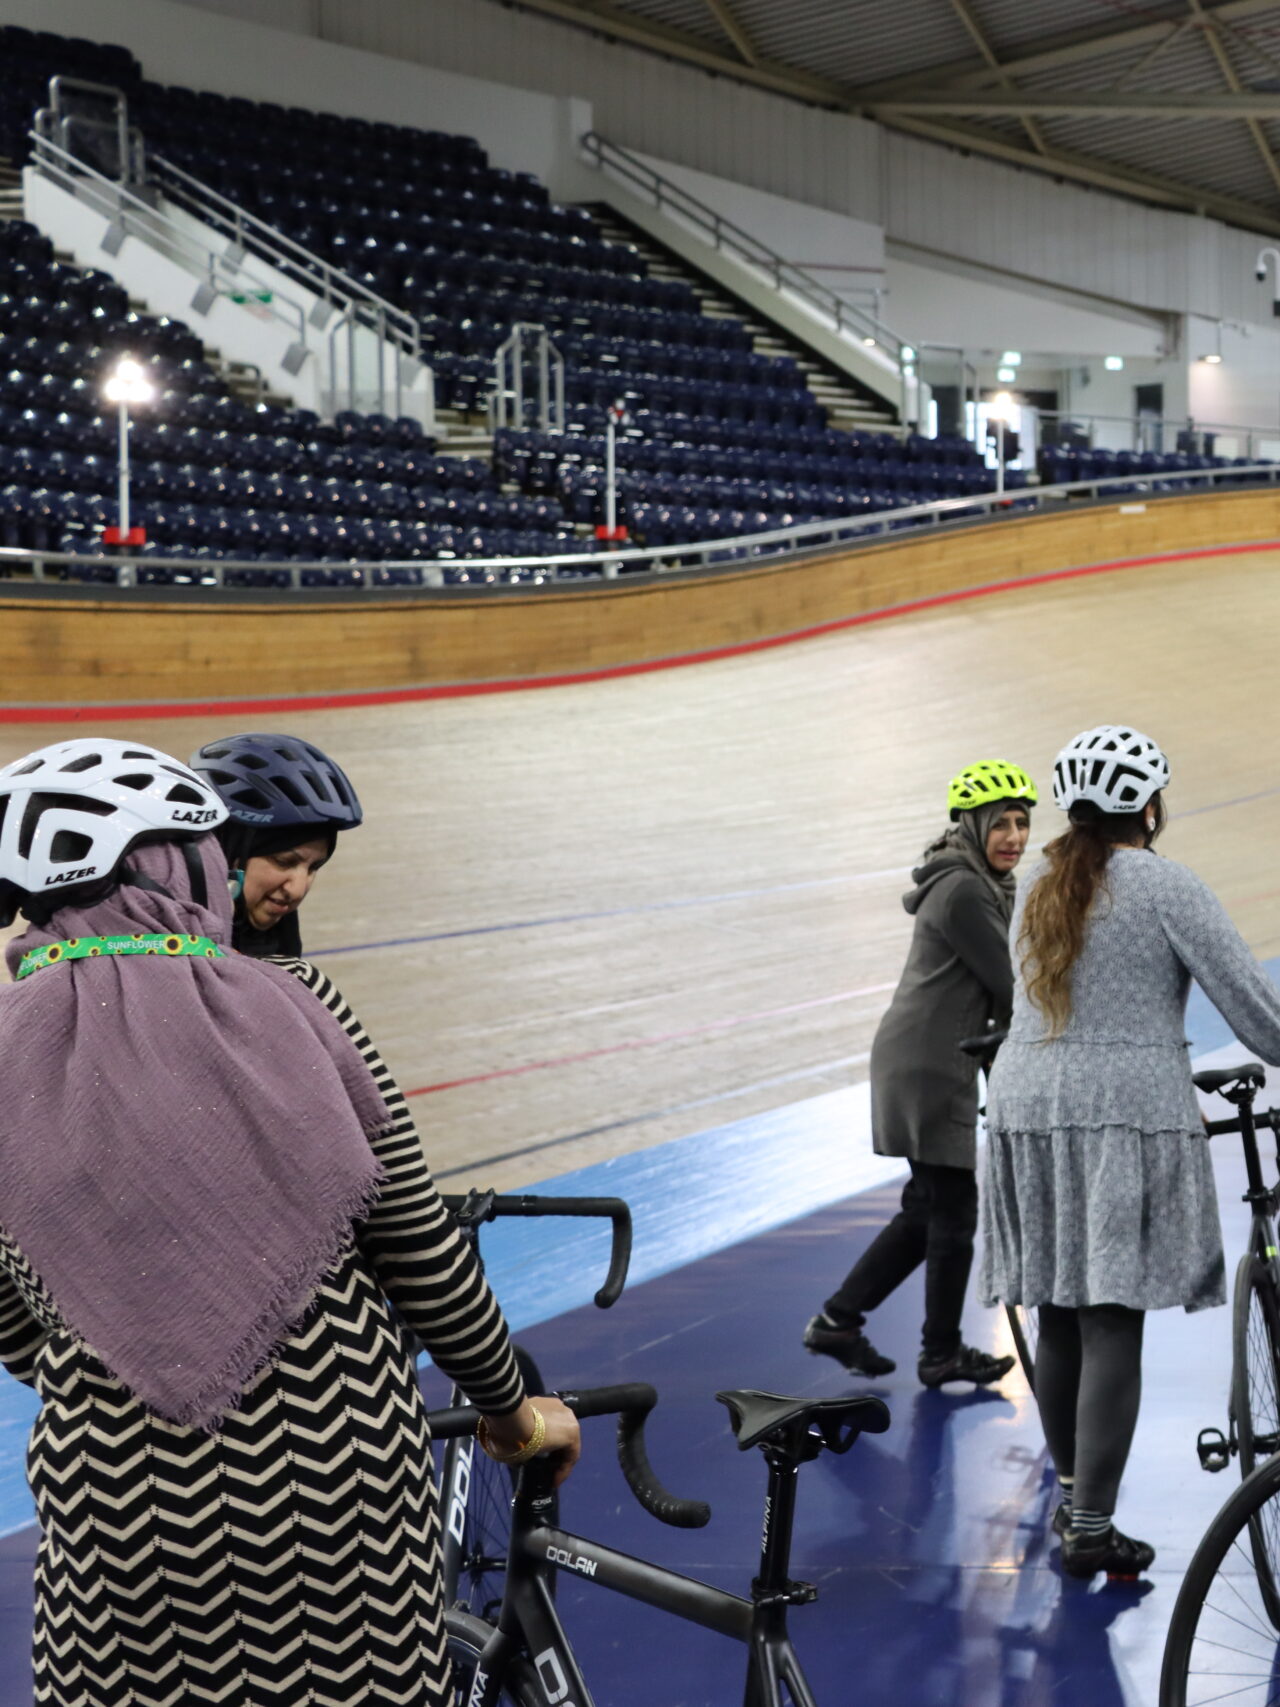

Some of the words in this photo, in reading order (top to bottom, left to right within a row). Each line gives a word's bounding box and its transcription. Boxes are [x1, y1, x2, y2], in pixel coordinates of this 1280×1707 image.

[171, 809, 218, 824] LAZER
[45, 866, 96, 886] LAZER
[107, 940, 165, 950] SUNFLOWER
[761, 1495, 772, 1554] ALPINA
[546, 1546, 598, 1576] DOLAN
